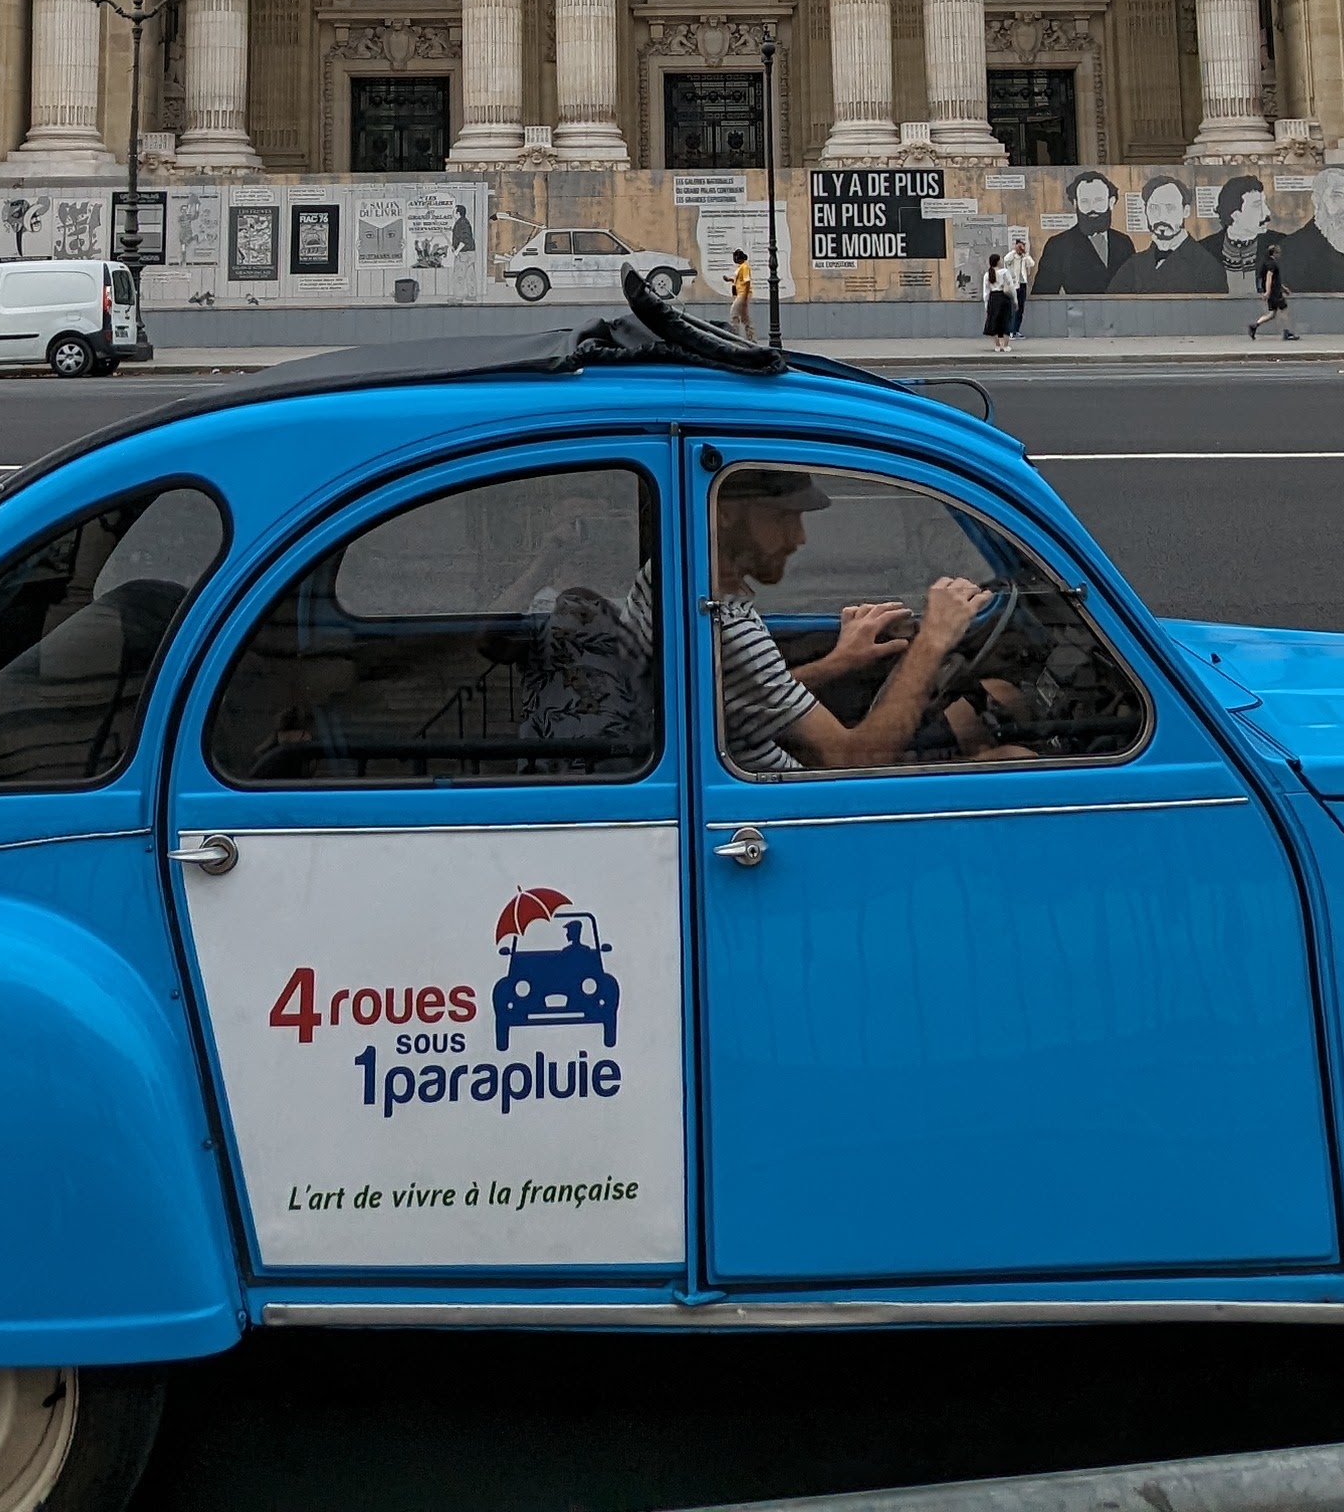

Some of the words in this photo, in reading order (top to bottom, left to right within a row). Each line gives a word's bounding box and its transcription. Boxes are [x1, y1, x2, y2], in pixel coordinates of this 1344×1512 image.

[813, 173, 828, 197] IL
[832, 173, 844, 197] Y
[849, 173, 863, 197] A
[868, 173, 890, 196] DE
[895, 173, 939, 196] PLUS
[814, 203, 835, 227] EN
[842, 203, 886, 227] PLUS
[814, 234, 838, 257] DE
[842, 233, 907, 257] MONDE
[269, 967, 322, 1044] 4
[329, 984, 477, 1026] roues
[396, 1032, 466, 1054] sous
[354, 1045, 376, 1105] 1
[384, 1050, 622, 1118] parapluie
[288, 1184, 346, 1211] L'art
[353, 1184, 383, 1208] de
[392, 1182, 456, 1208] vivre
[465, 1181, 480, 1206] à
[488, 1180, 512, 1206] la
[516, 1175, 639, 1211] française
